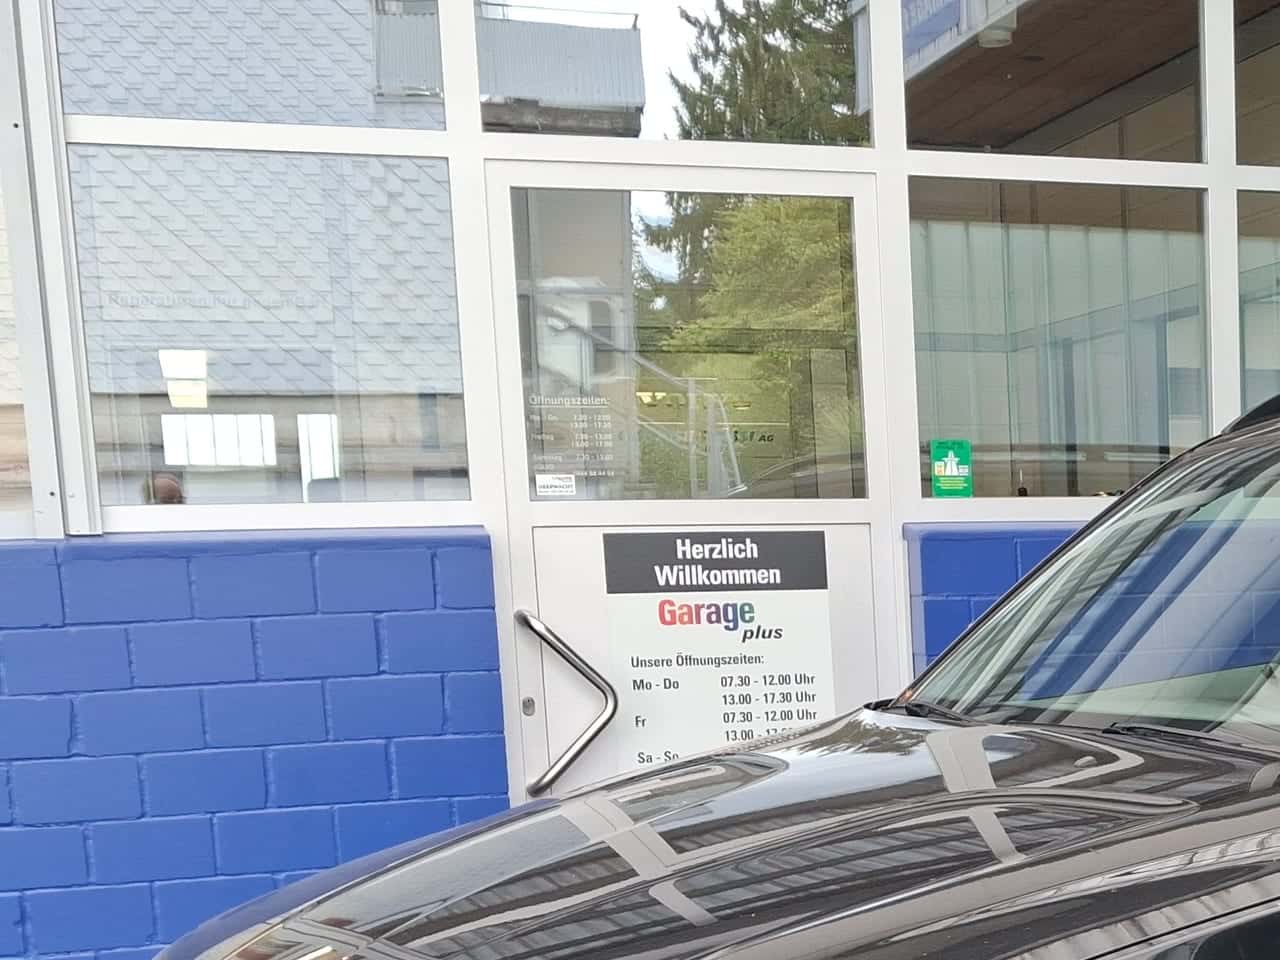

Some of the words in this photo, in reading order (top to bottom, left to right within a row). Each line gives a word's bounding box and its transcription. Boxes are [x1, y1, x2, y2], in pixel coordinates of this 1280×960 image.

[676, 538, 758, 560] Herzlich
[654, 565, 781, 586] Willkommen
[658, 599, 755, 631] Garage
[741, 625, 783, 643] plus
[631, 656, 673, 668] Unsere
[676, 652, 765, 668] Öffnungszeiten:
[632, 679, 652, 691] Mo
[663, 678, 680, 691] Do
[720, 676, 750, 687] 07.30
[762, 674, 791, 686] 12.00
[794, 673, 815, 685] Uhr
[722, 694, 752, 706] 13.00
[763, 692, 792, 705] 17.30
[795, 691, 816, 703] Uhr
[635, 715, 647, 728] Fr
[723, 712, 752, 724] 07.30
[765, 710, 793, 722] 12.00
[796, 709, 817, 721] Uhr
[725, 729, 754, 742] 13.00
[637, 752, 652, 763] Sa
[664, 751, 679, 763] So
